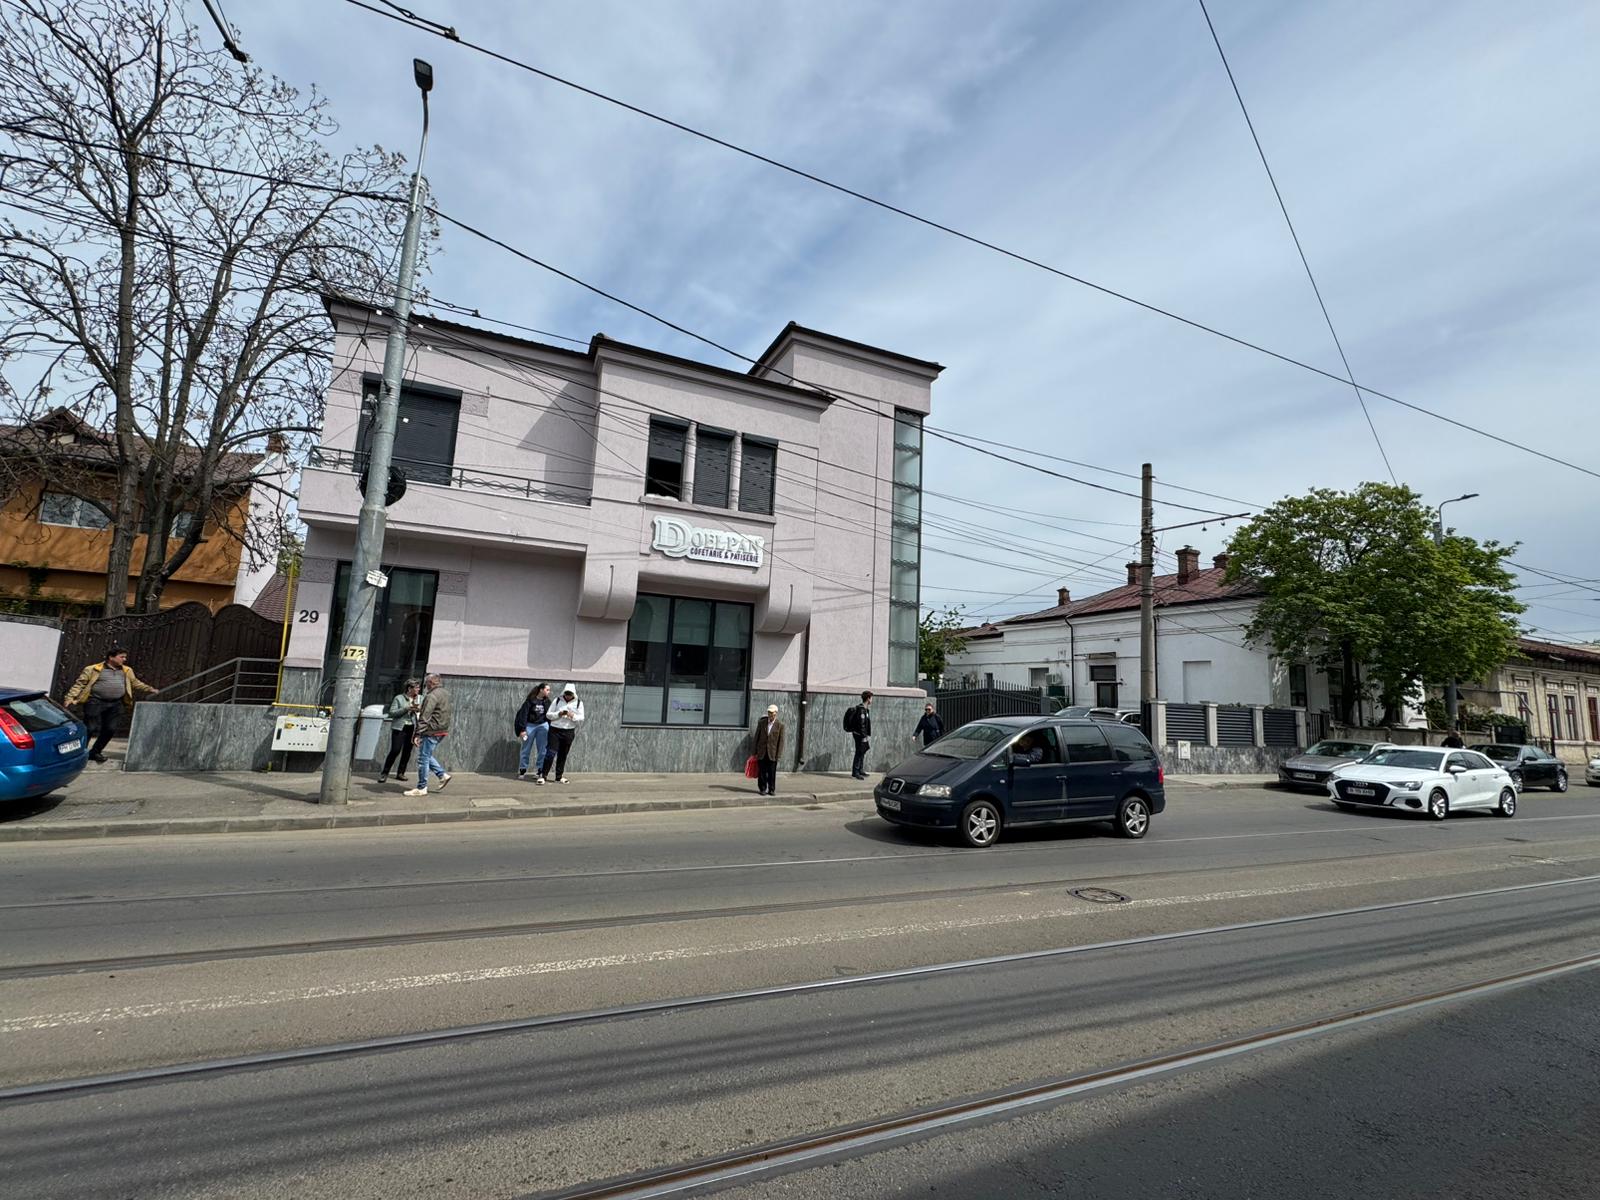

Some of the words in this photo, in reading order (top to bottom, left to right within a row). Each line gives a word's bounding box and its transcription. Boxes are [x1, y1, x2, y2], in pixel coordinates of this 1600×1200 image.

[690, 547, 722, 559] COFETARIE
[730, 552, 759, 563] PATISERIE
[298, 609, 319, 624] 29
